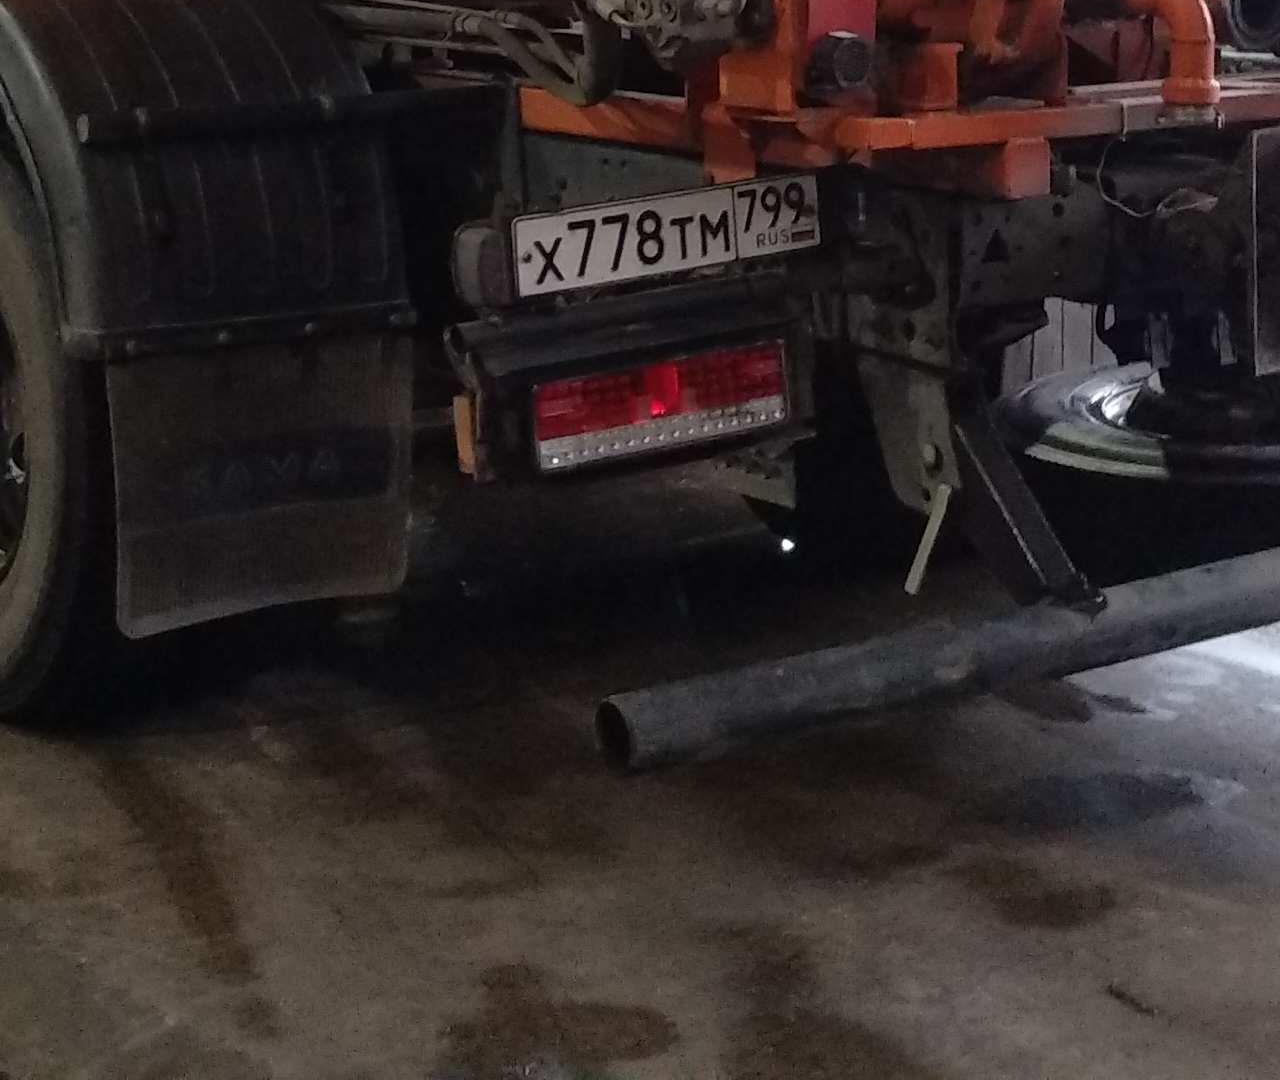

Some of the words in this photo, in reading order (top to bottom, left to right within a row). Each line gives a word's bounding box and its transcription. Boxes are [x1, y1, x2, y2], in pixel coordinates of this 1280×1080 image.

[533, 209, 730, 285] Х778ТМ
[737, 181, 806, 233] 799
[755, 231, 790, 249] RUS
